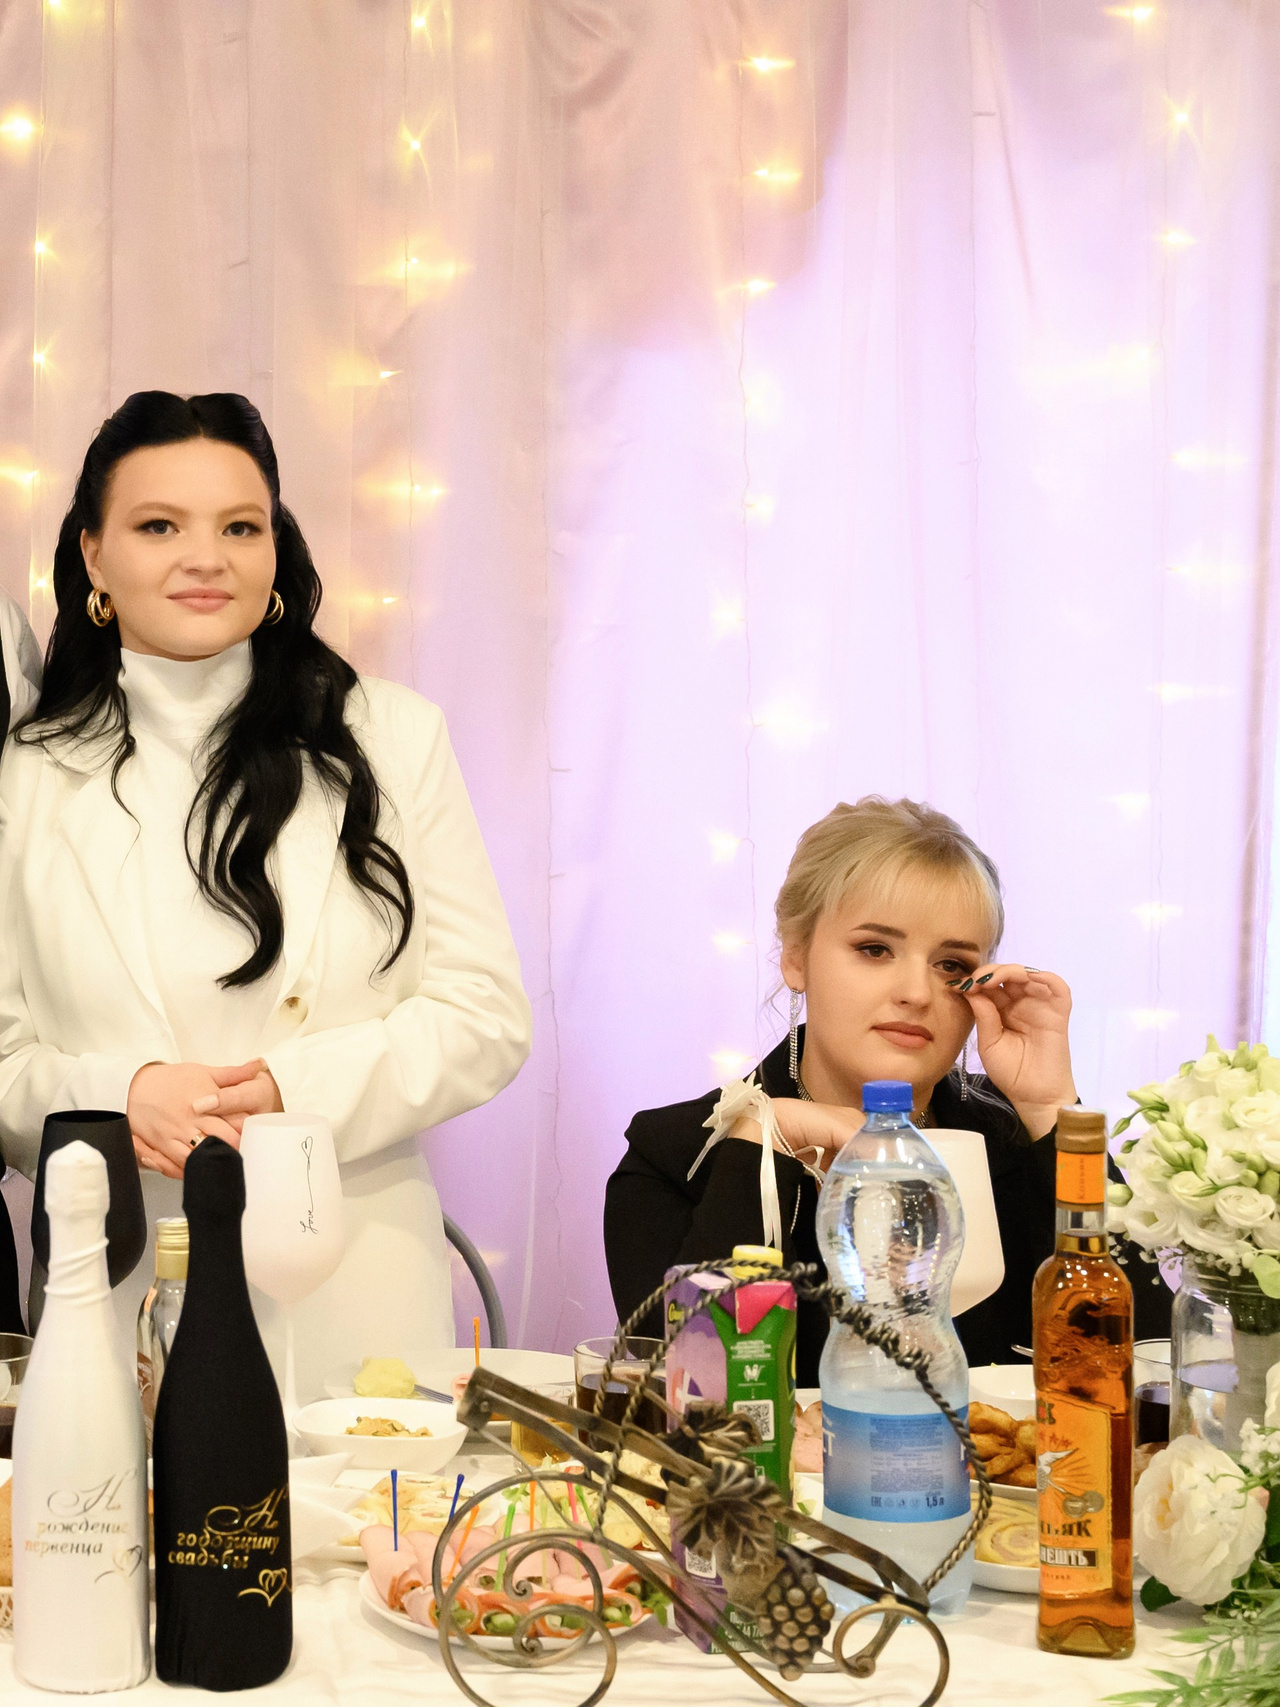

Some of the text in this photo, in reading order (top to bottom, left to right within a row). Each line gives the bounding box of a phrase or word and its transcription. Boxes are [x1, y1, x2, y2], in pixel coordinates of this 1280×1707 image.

[24, 1539, 104, 1557] первенца
[176, 1528, 280, 1556] годовщину
[167, 1546, 250, 1570] свадьбы
